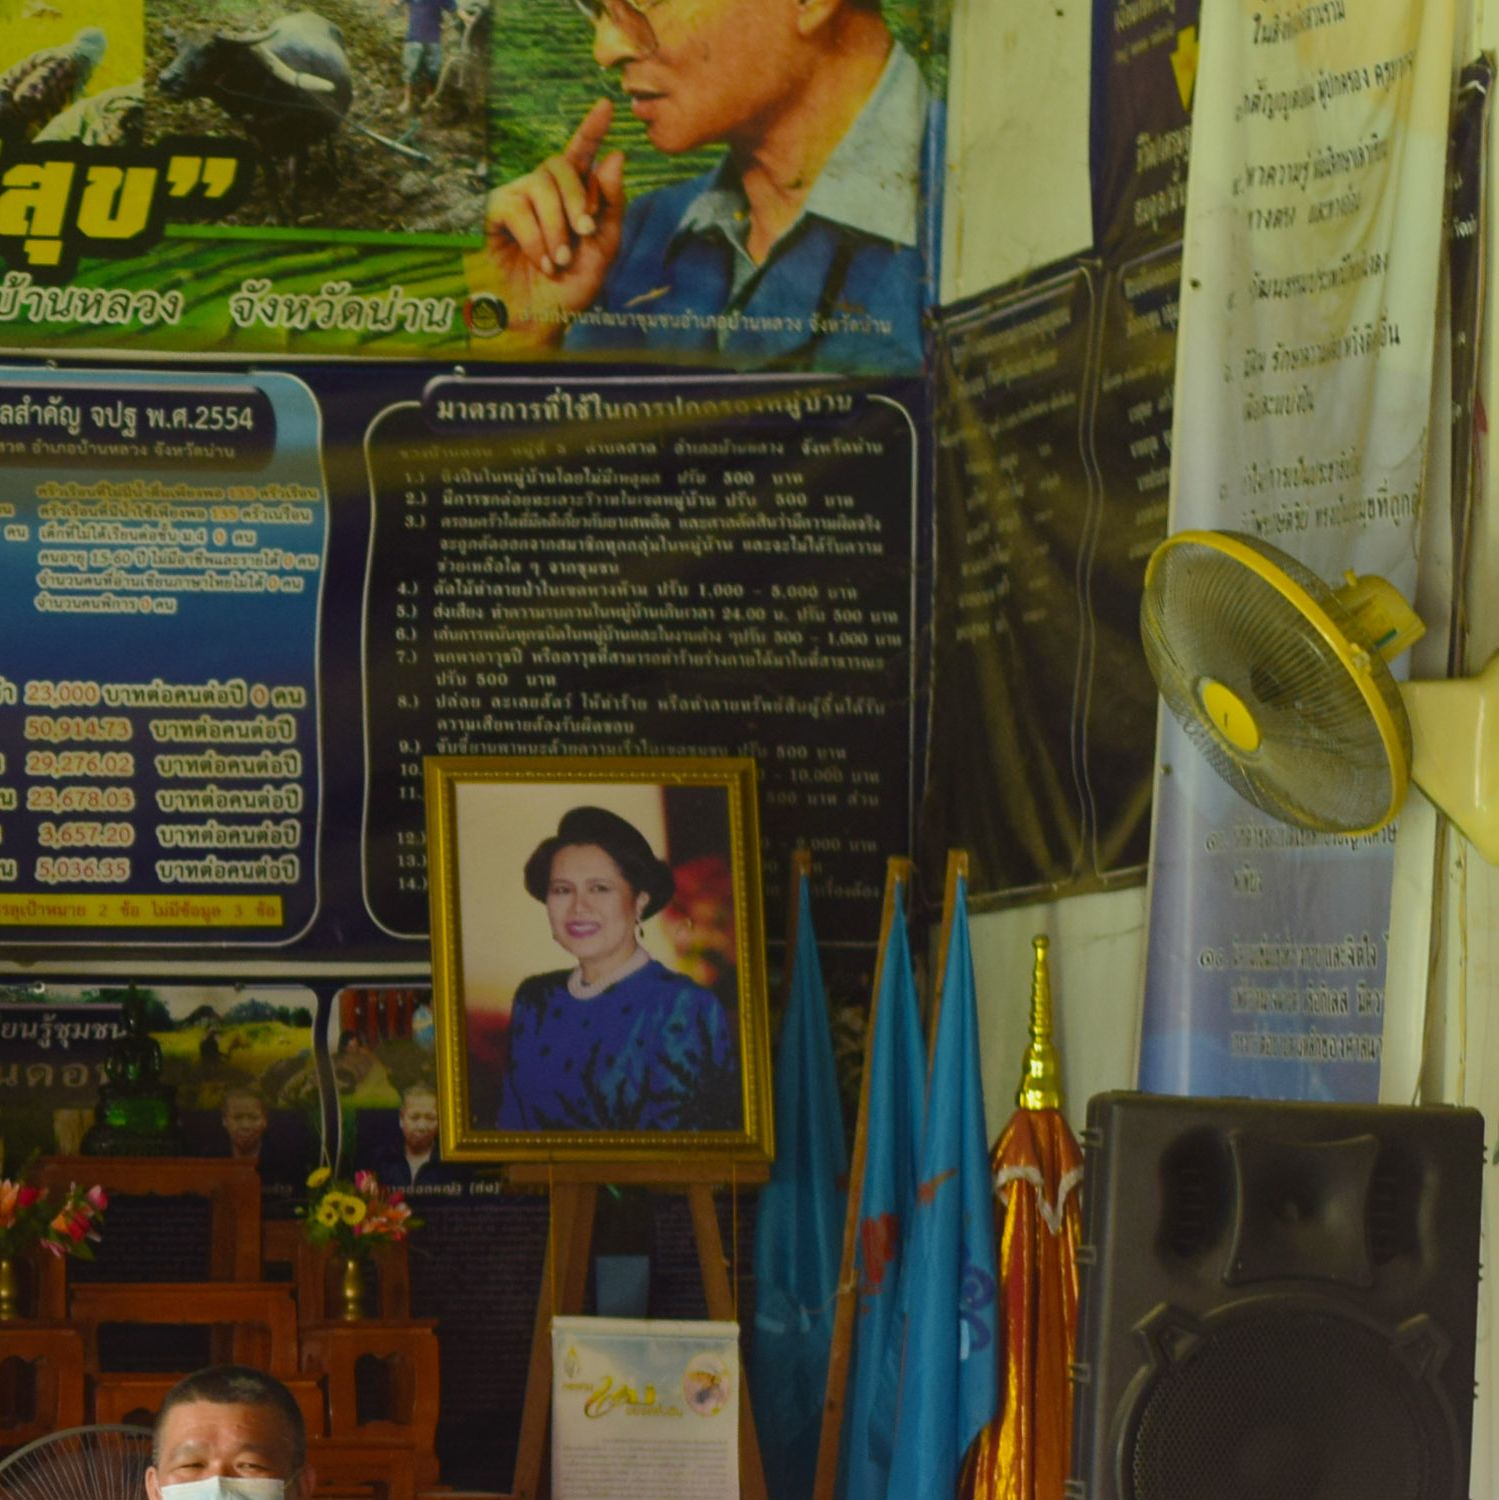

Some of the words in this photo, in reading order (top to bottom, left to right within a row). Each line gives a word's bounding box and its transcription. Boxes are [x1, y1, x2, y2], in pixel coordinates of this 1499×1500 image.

[231, 277, 453, 335] จังหวัดน่าน
[89, 399, 139, 438] จปฐ
[145, 404, 254, 431] พ.ศ.2554
[32, 438, 148, 457] อำเภอบ้านหลวง
[154, 440, 236, 459] จังหวัดน่าน
[5, 525, 28, 540] คน
[214, 528, 226, 545] 0
[232, 530, 256, 545] คน
[39, 551, 87, 569] คนอายุ
[297, 554, 317, 568] คน
[281, 576, 303, 591] คน
[140, 597, 152, 613] 0
[154, 598, 176, 613] คน
[25, 682, 100, 707] 23,000
[103, 679, 247, 707] บาทต่อคนต่อปี
[252, 684, 268, 707] 0
[272, 686, 305, 707] คน
[476, 673, 509, 686] 500
[525, 673, 557, 688] บาท
[25, 717, 132, 741] 50,914.73
[151, 715, 295, 742] บาทต่อคนต่อปี
[26, 752, 133, 777] 29,276.02
[156, 750, 301, 777] บาทต่อคนต่อปี
[27, 788, 134, 812] 23,678.03
[157, 784, 301, 812] บาทต่อคนต่อปี
[39, 823, 134, 848] 3,657.20
[157, 820, 300, 848] บาทต่อคนต่อปี
[35, 858, 131, 884] 5,036.35
[156, 855, 299, 883] บาทต่อคนต่อปี
